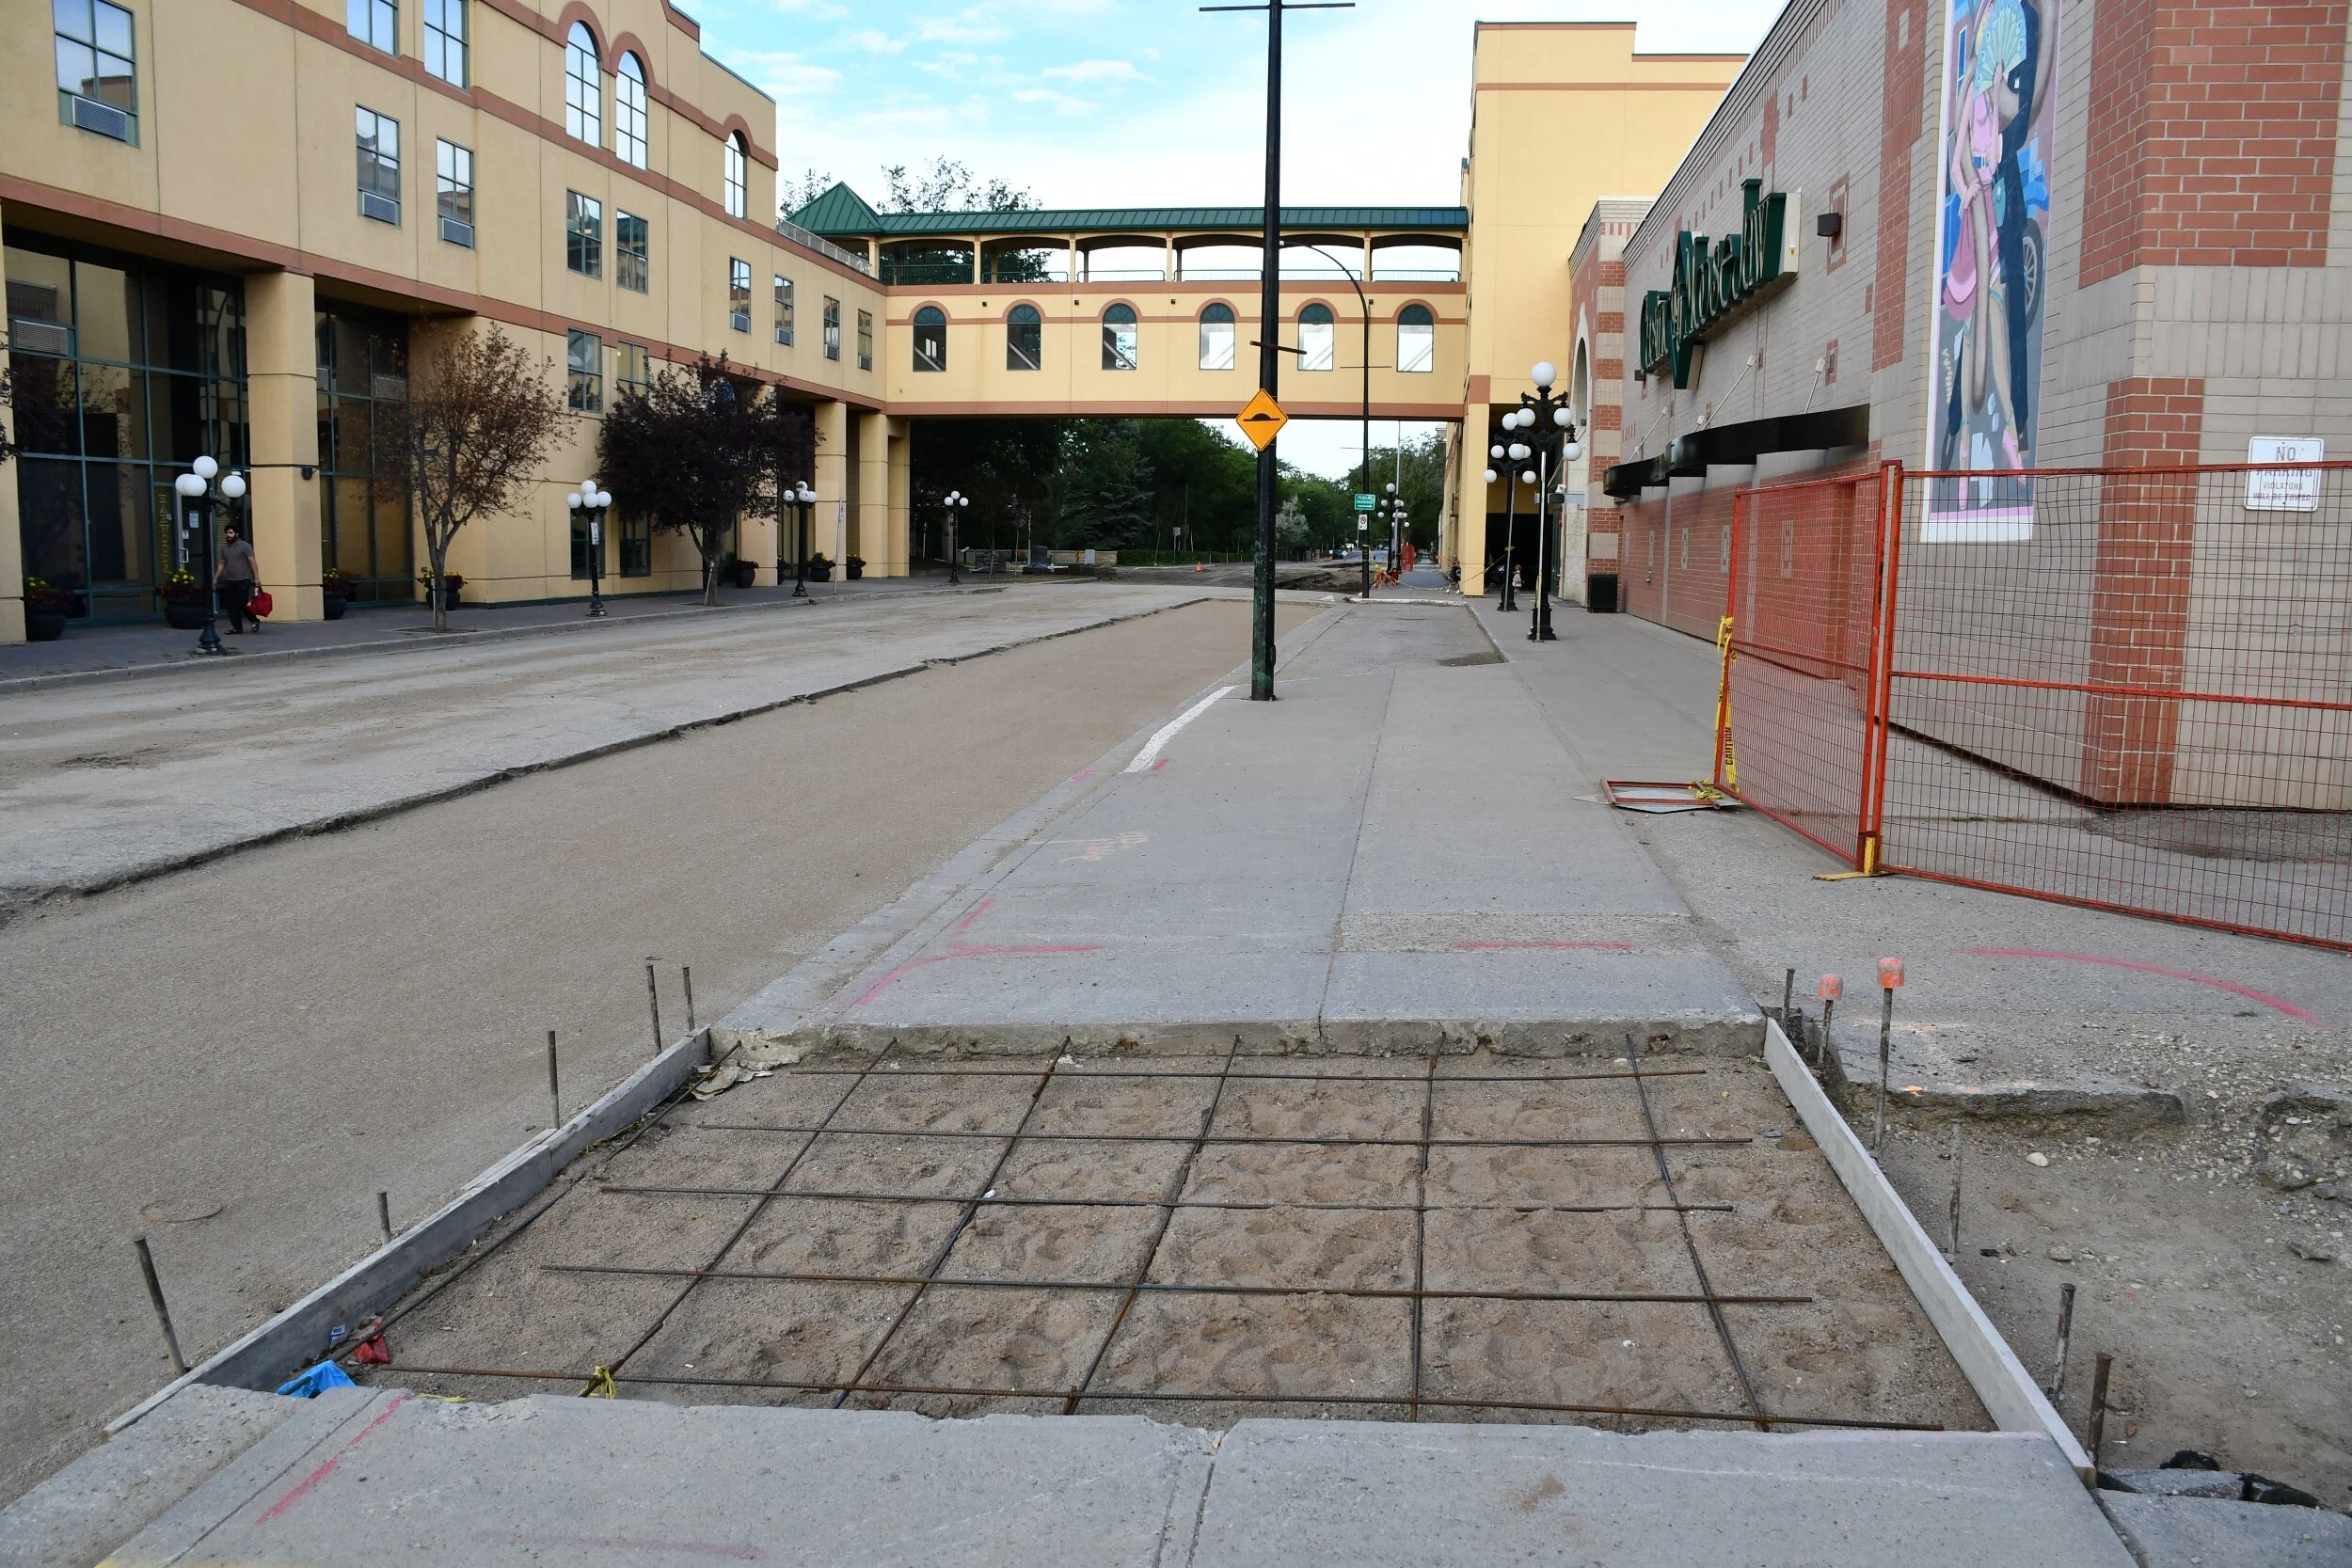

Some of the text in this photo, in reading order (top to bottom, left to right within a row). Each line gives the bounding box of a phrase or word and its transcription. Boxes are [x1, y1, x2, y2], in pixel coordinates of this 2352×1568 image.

[2276, 446, 2296, 461] NO
[2263, 482, 2303, 490] VIOLATORS
[1724, 726, 1734, 766] CAUTION
